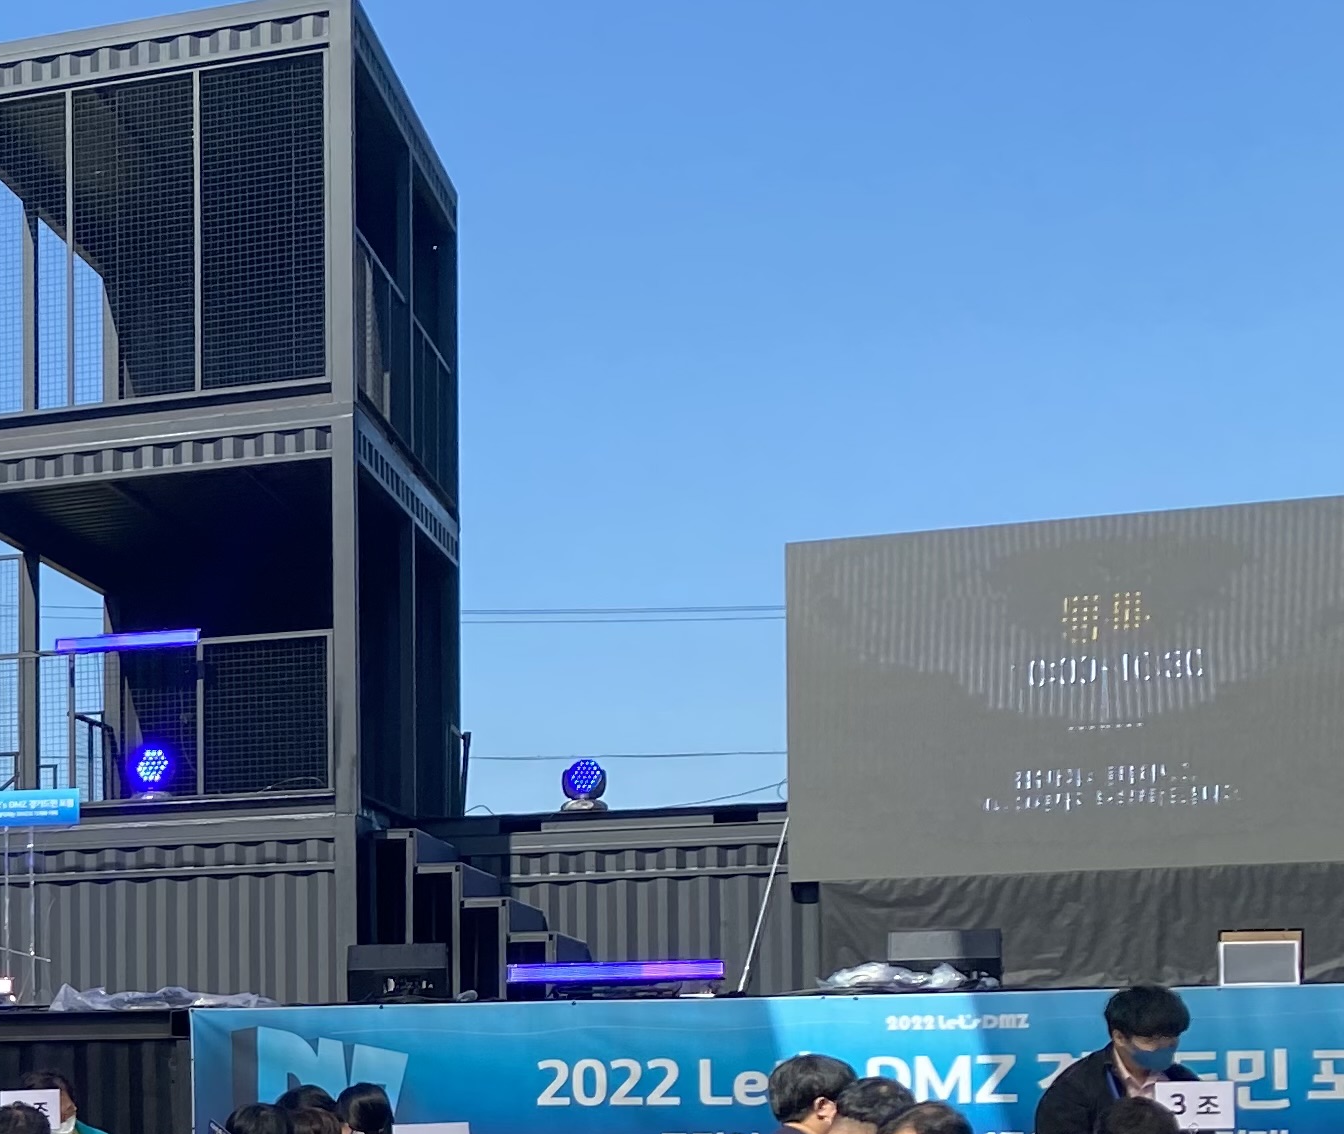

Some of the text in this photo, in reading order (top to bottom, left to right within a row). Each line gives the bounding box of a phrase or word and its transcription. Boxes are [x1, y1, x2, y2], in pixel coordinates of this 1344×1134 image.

[886, 1014, 935, 1031] 2022
[537, 1058, 681, 1107] 2022
[1169, 1093, 1222, 1117] 3 조
